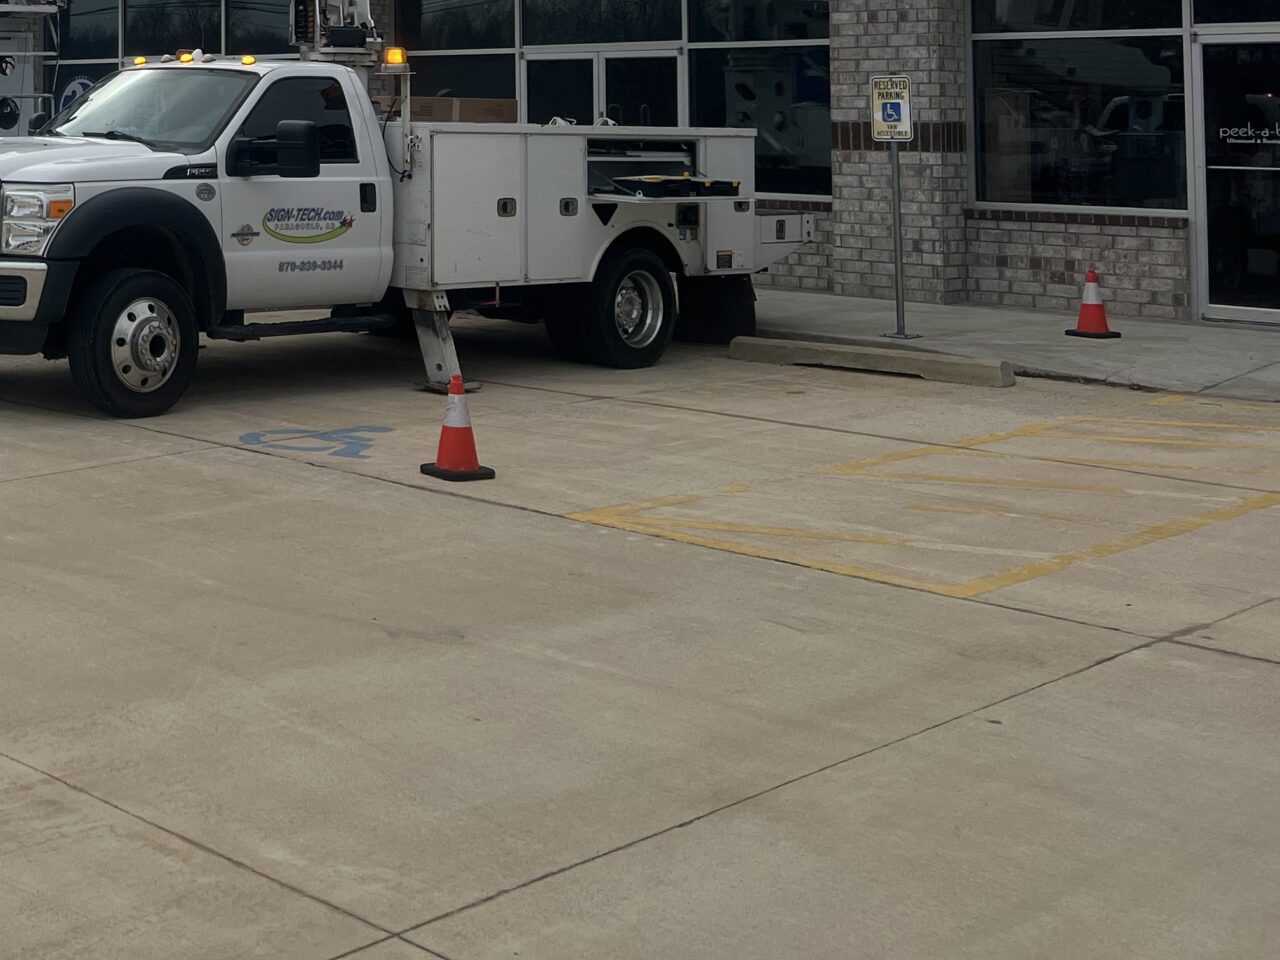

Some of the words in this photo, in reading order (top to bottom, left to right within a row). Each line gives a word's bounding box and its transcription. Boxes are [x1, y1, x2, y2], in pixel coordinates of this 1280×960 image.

[873, 80, 907, 90] RESERVED
[877, 91, 904, 100] PARKING
[267, 208, 344, 222] SIGN-TECH.com
[278, 260, 344, 272] 870-239-3344
